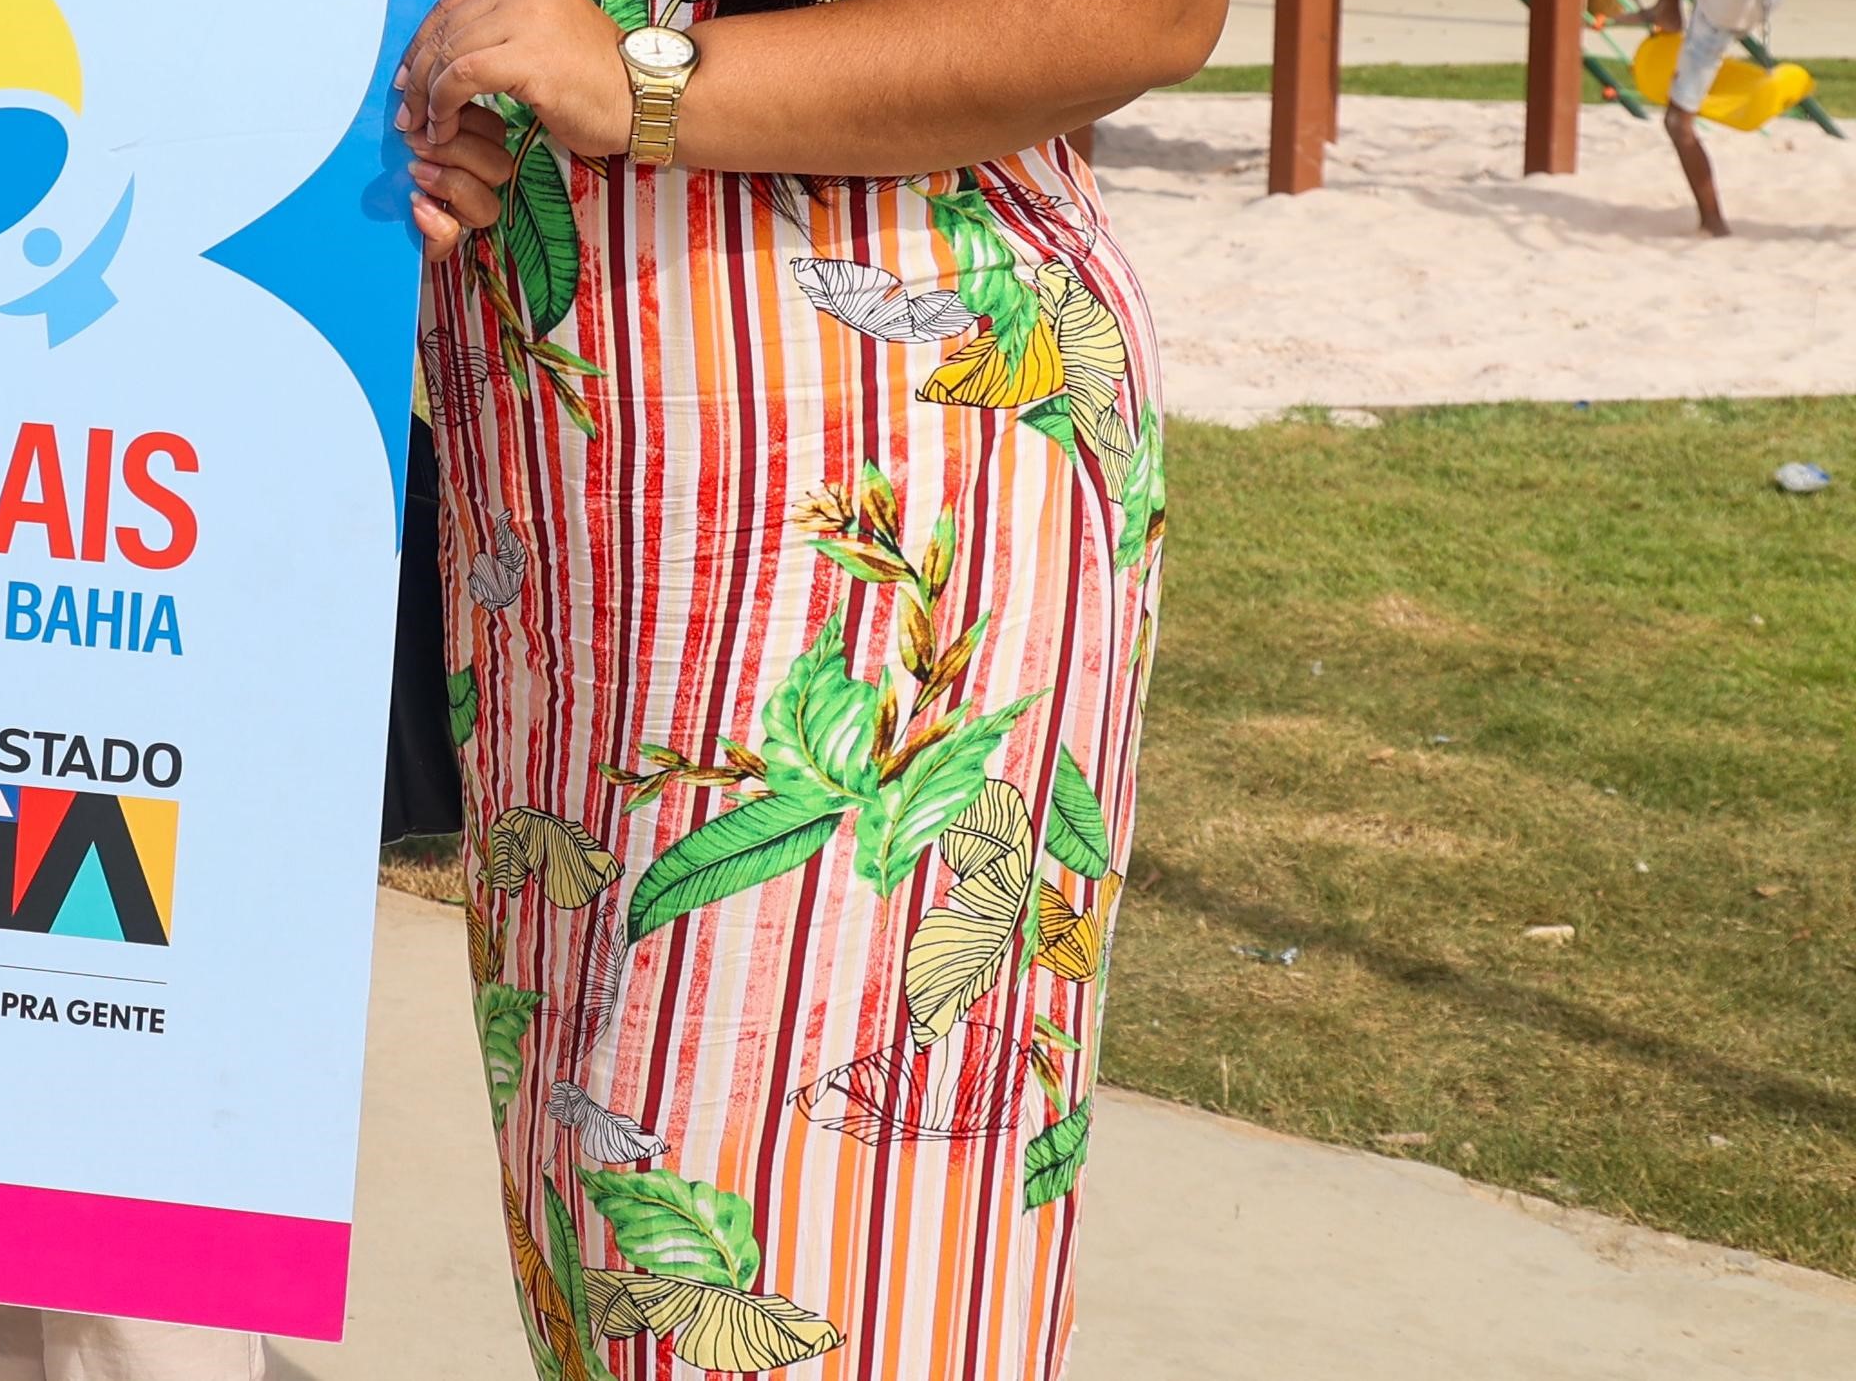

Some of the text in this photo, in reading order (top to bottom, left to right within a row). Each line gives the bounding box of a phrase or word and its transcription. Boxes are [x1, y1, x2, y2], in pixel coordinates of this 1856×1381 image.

[4, 580, 184, 656] BAHIA
[0, 991, 59, 1023] PRA
[66, 999, 166, 1034] GENTE
